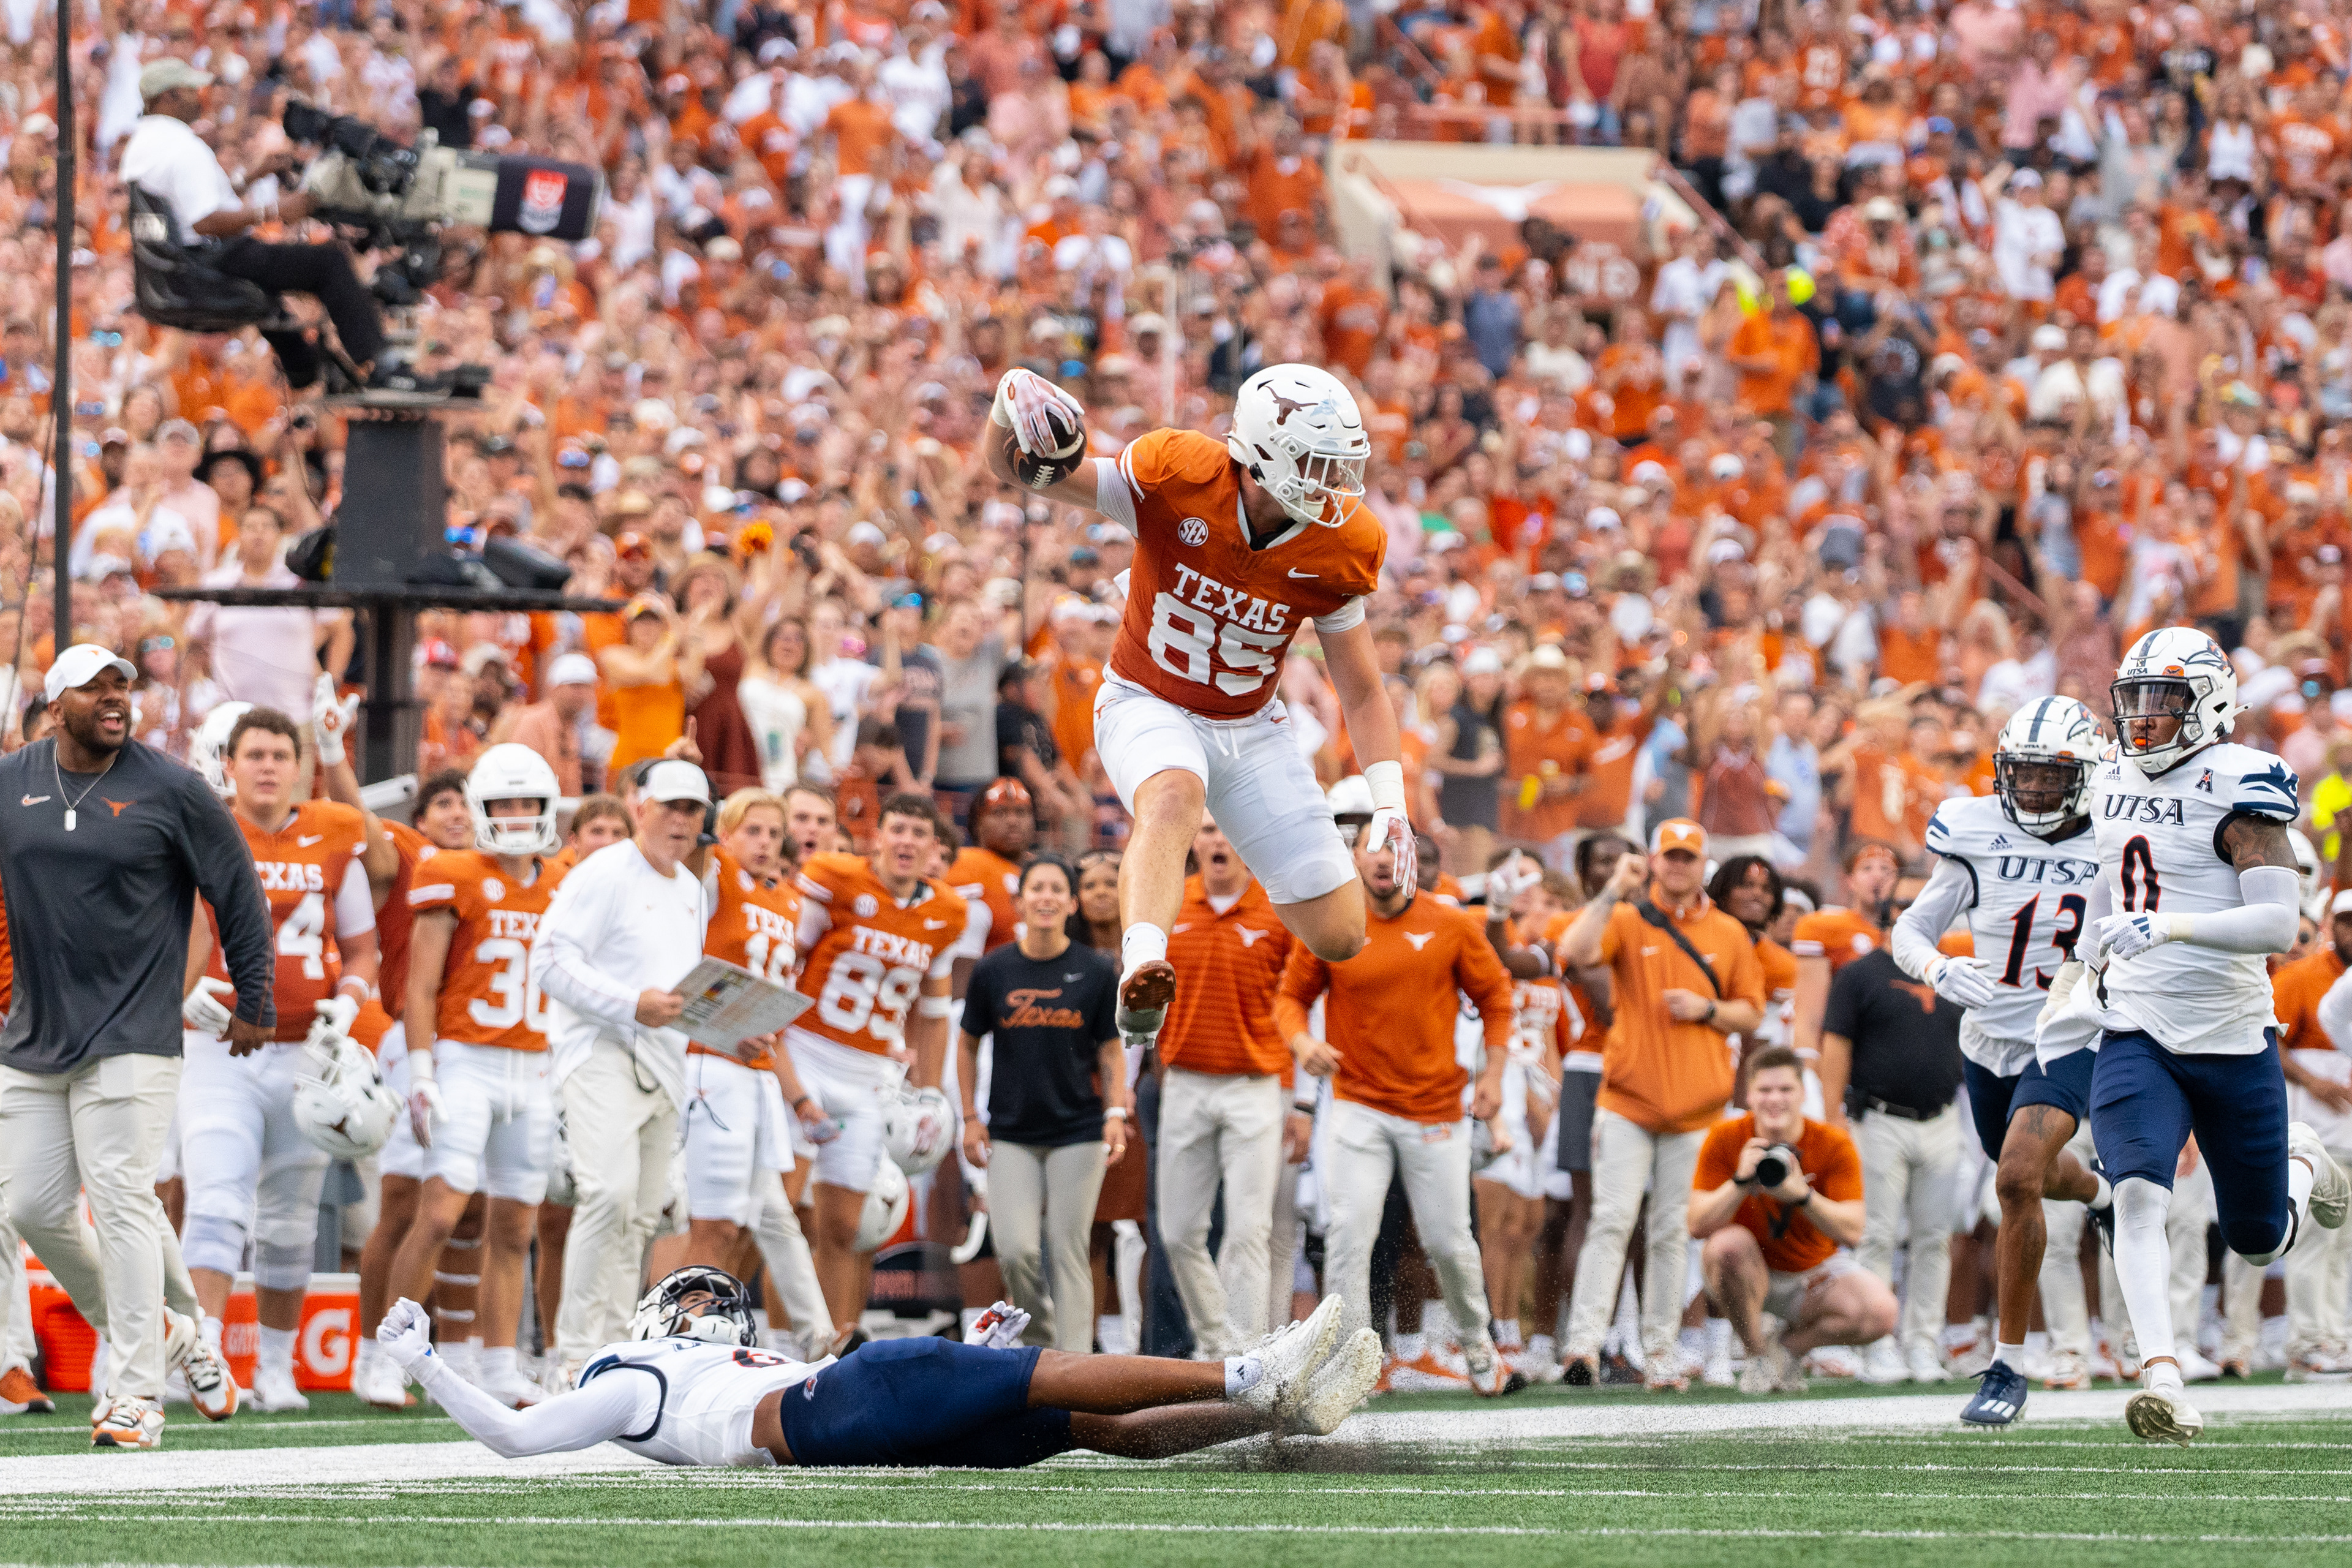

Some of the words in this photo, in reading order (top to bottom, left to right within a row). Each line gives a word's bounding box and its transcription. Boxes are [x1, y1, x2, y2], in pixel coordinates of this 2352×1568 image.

[1180, 519, 1207, 545] SEC
[1172, 562, 1291, 633] TEXAS
[1147, 592, 1289, 696] 85
[2103, 794, 2185, 826] UTSA
[255, 861, 324, 892] XAS
[1997, 856, 2100, 886] UTSA
[2120, 834, 2162, 914] 0
[267, 892, 326, 980] 4
[488, 909, 544, 941] TEX
[741, 901, 795, 946] TEXA
[1997, 891, 2087, 992] 13
[851, 924, 933, 972] TEXAS
[816, 949, 924, 1051] 89
[998, 987, 1085, 1029] Texas
[303, 1308, 352, 1378] G
